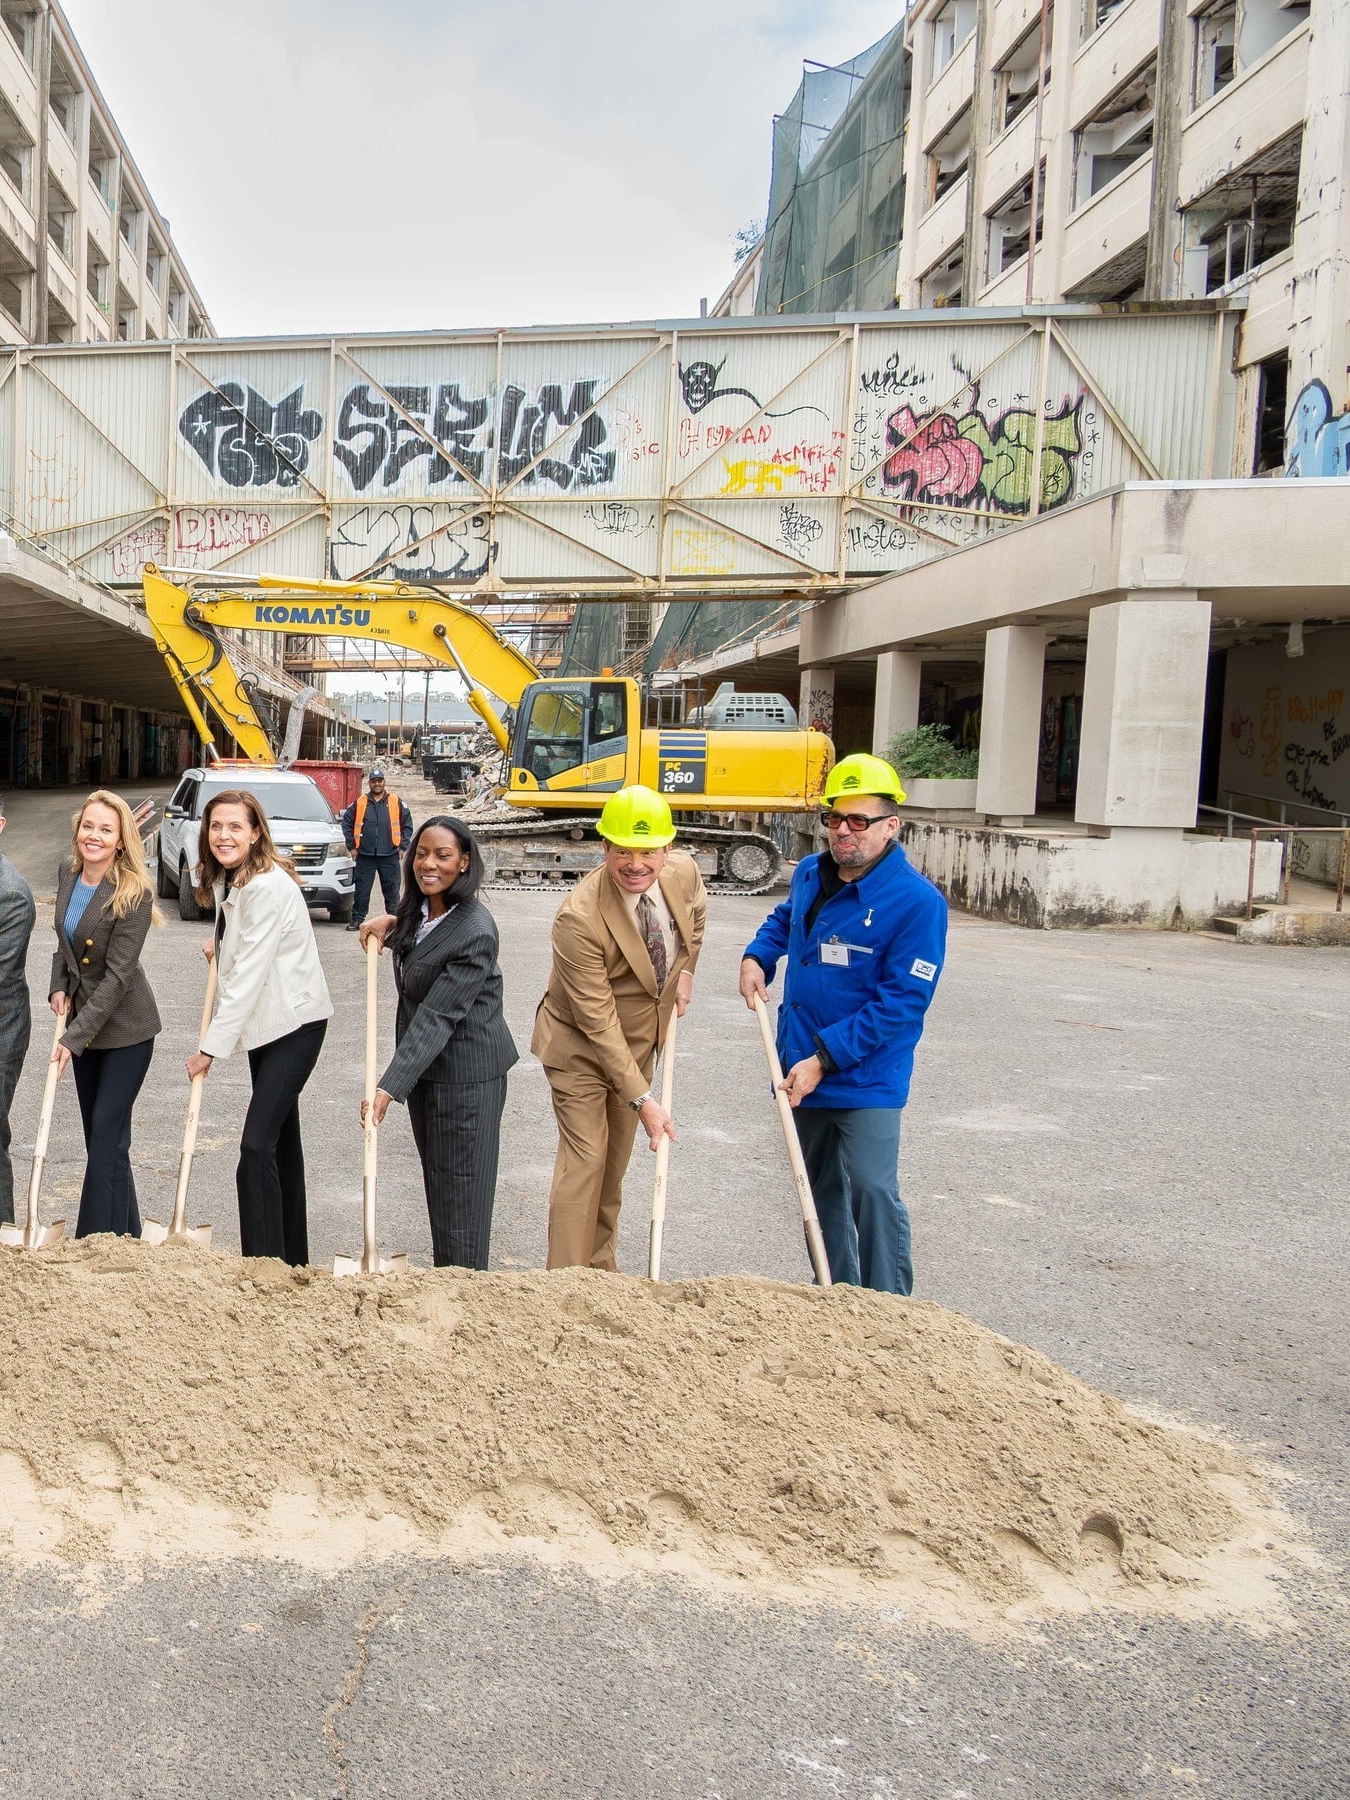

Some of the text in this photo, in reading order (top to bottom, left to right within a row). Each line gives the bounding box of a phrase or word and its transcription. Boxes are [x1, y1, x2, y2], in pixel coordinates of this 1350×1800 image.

[255, 604, 370, 627] KOMATSU
[664, 762, 681, 771] PC
[663, 772, 694, 783] 360
[663, 784, 675, 792] LC
